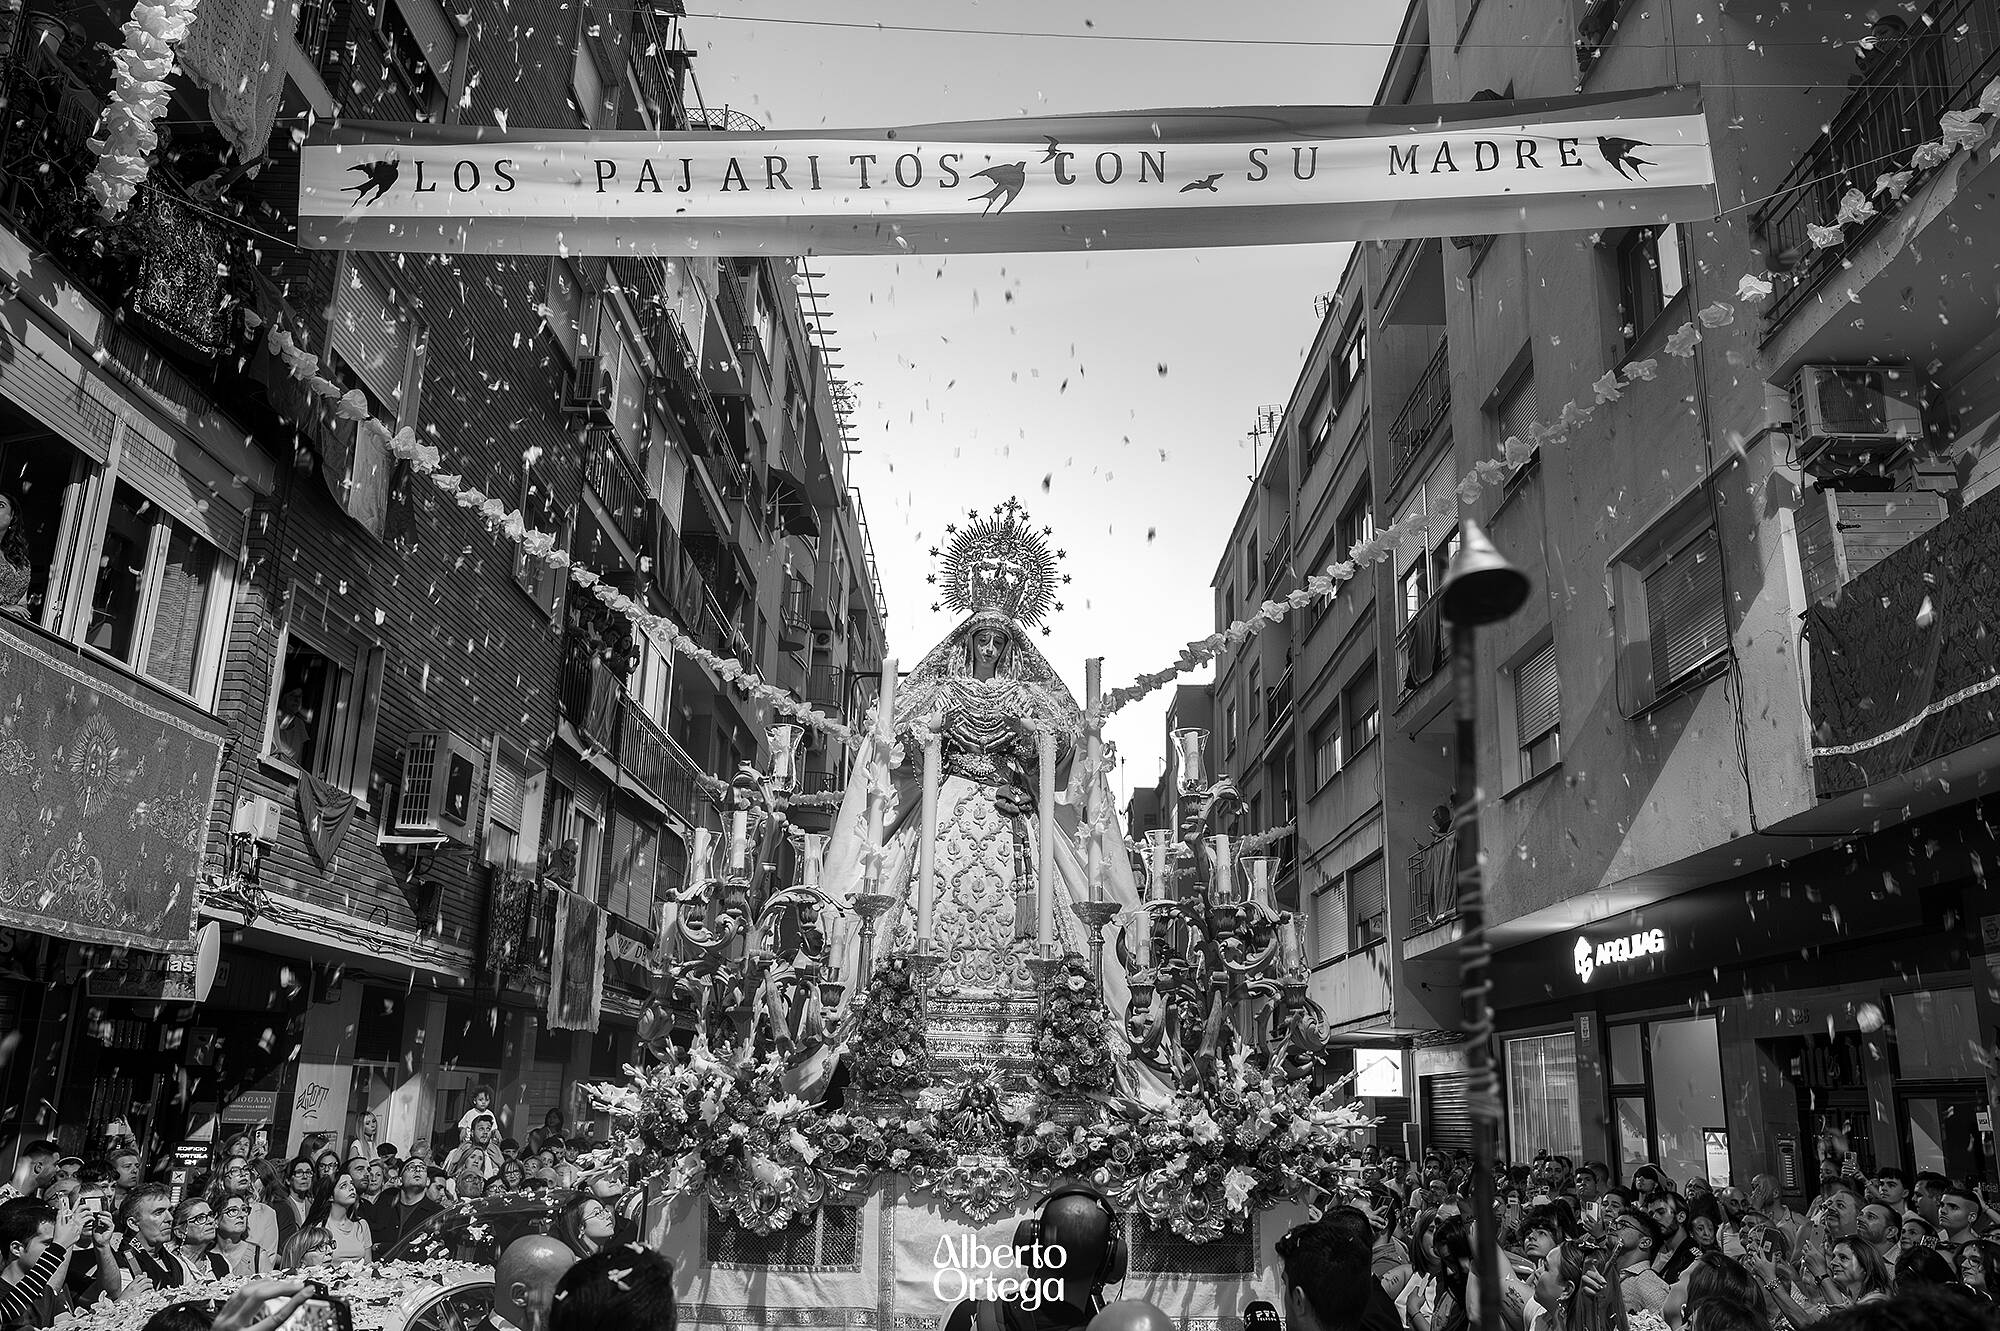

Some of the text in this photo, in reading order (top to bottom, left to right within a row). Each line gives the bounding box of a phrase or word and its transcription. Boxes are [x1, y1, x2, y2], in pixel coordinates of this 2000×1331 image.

[413, 137, 1583, 194] LOS PAJARITOS CON SU MADRE
[1595, 928, 1665, 967] ARQUIAG
